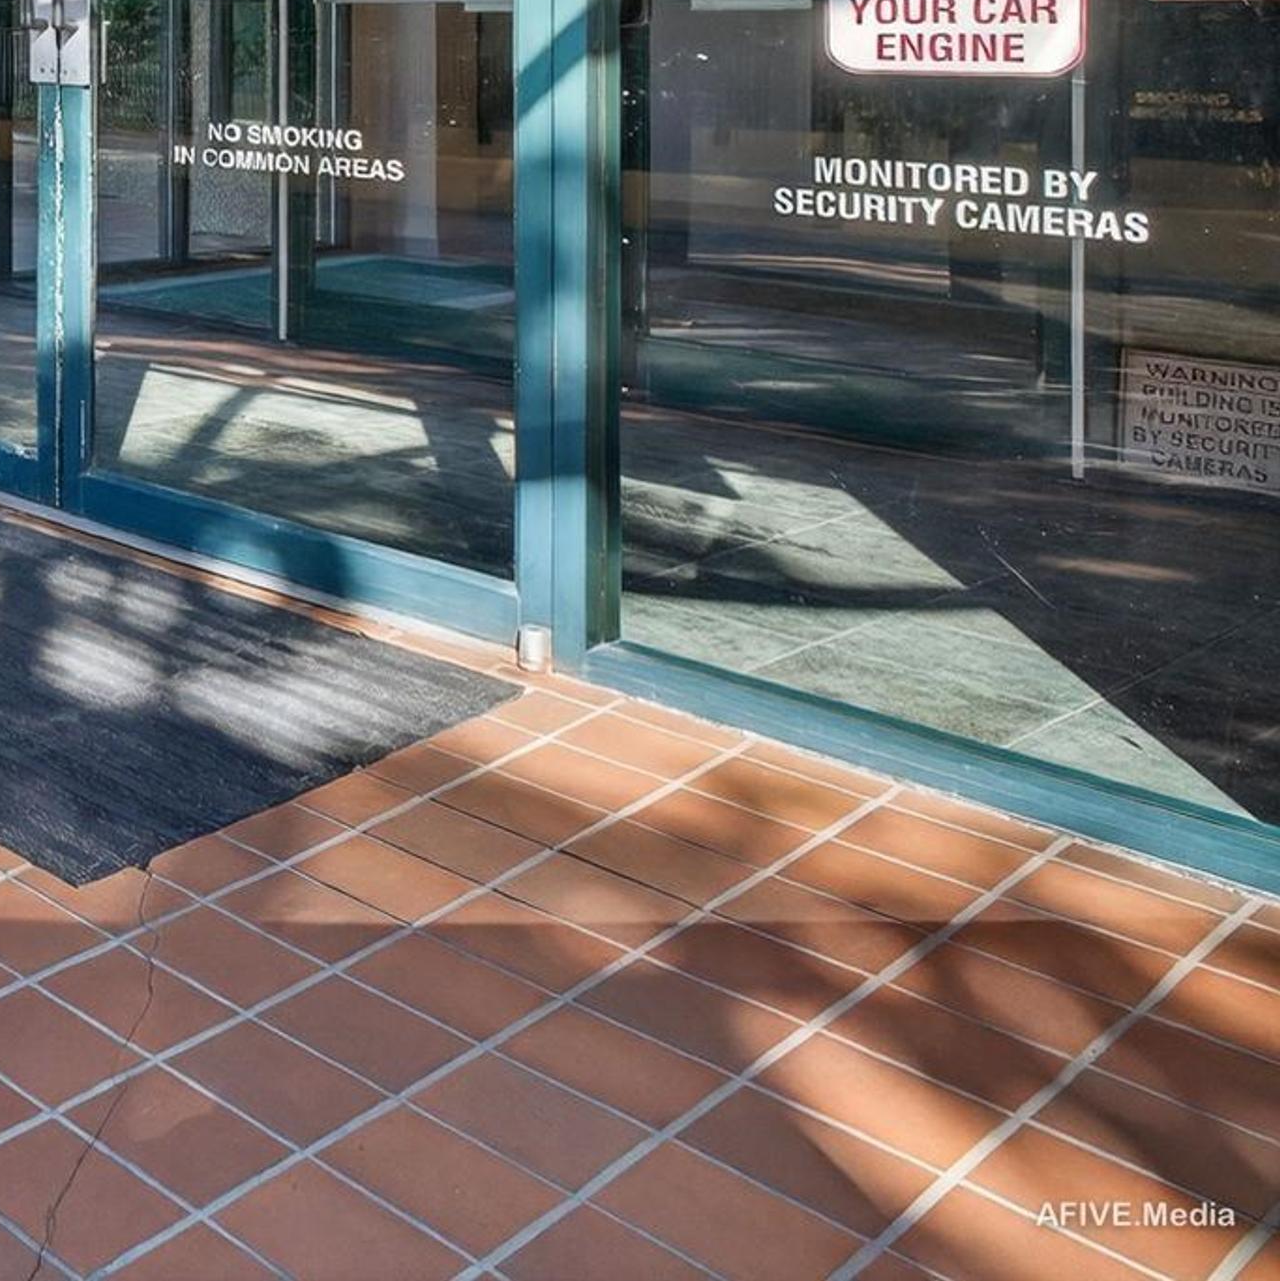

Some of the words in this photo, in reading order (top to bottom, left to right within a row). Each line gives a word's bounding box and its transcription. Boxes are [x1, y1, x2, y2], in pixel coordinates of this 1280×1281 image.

[875, 32, 1026, 63] ENGINE
[207, 122, 242, 143] NO
[246, 123, 364, 151] SMOKING
[173, 144, 196, 165] IN
[202, 147, 311, 175] COMMON
[317, 156, 406, 182] AREAS
[813, 156, 1029, 197] MONITORED
[1043, 168, 1098, 202] BY
[773, 186, 945, 227] SECURITY
[955, 199, 1150, 244] CAMERAS
[1170, 430, 1280, 460] SECURIT
